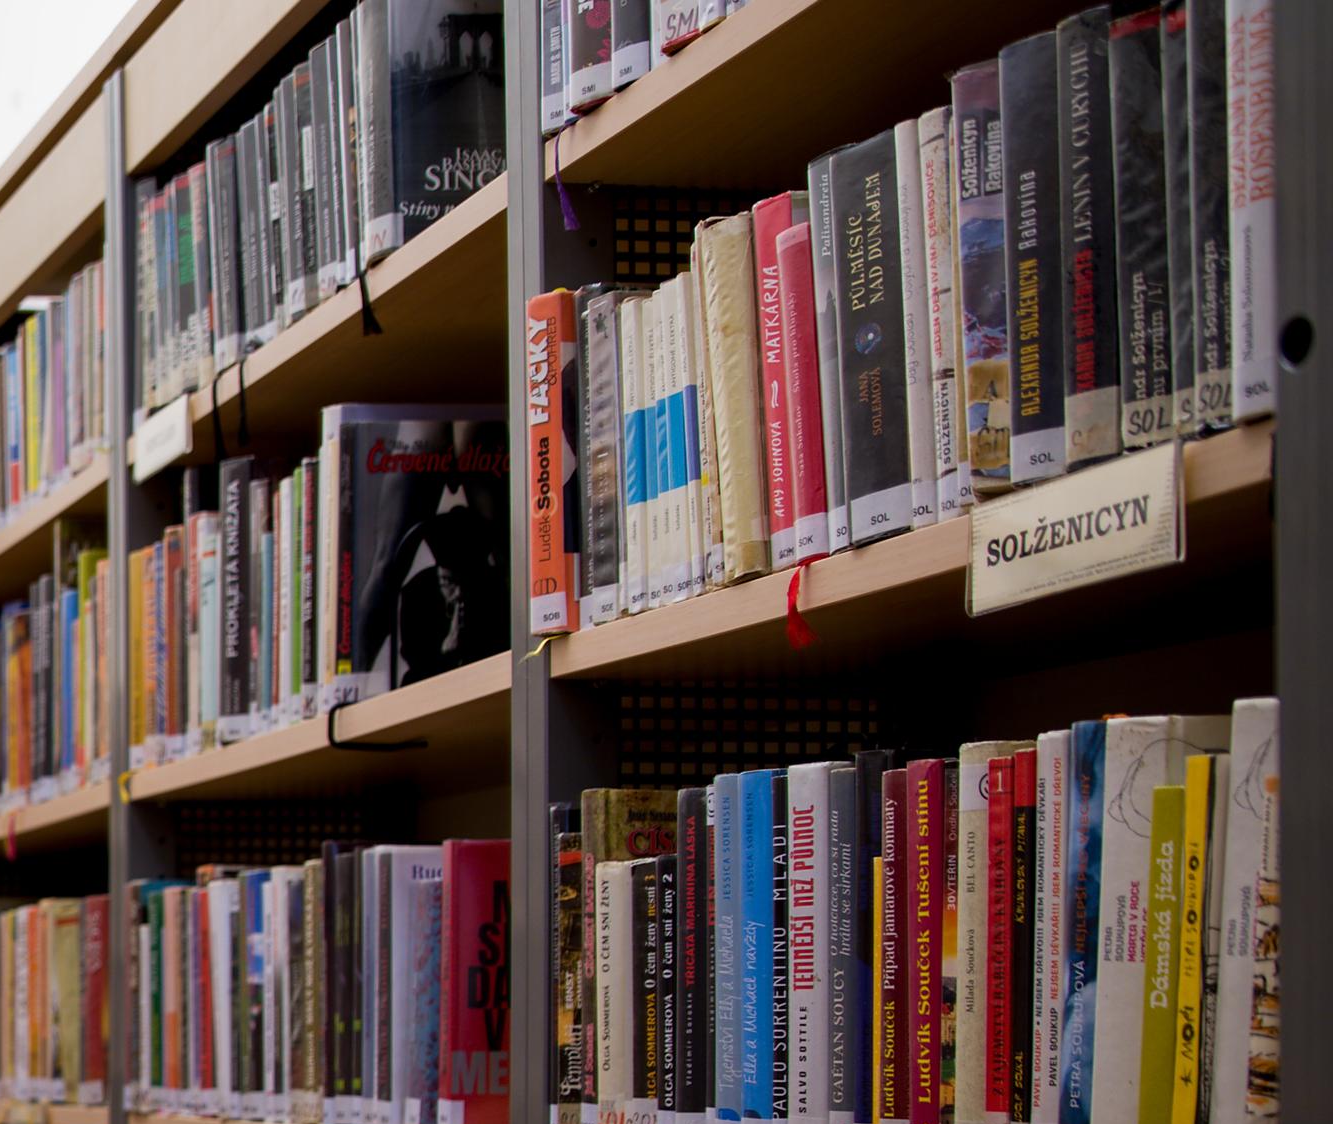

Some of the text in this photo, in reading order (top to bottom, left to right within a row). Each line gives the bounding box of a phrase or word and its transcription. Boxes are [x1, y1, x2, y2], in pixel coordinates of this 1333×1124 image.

[1070, 39, 1092, 243] LENIN CURYCHU
[1249, 5, 1274, 203] ROSENBLUMA
[456, 146, 502, 165] ISAAC
[961, 119, 978, 197] Solženicyn
[984, 120, 1002, 192] Rakovina
[819, 174, 832, 256] Palisandreia
[865, 172, 884, 303] NAD DUNAJEM
[1018, 170, 1038, 249] Rakovina
[848, 212, 866, 311] PŮLMĚSÍC
[762, 264, 781, 363] MATKÁRNA
[1016, 258, 1040, 416] ALEXANDR SOLŽENICYN
[1131, 273, 1145, 364] Solženicyn
[529, 318, 550, 426] FACKY
[859, 371, 869, 403] JANA
[870, 367, 883, 436] SOLEMOVÁ
[538, 437, 551, 561] Luděk Sobota
[770, 421, 786, 517] AMY SOHNOVÁ
[1030, 453, 1055, 465] SOL
[871, 513, 890, 526] SOL
[987, 495, 1150, 567] SOLŽENICYN
[600, 879, 610, 907] ŽENY
[685, 863, 696, 930] MARININA
[722, 797, 731, 900] JESSICA SORENSEN
[881, 798, 898, 989] Případ jantarové komnaty
[915, 779, 930, 922] Tušení stínu
[966, 831, 976, 892] BEL CANTO
[645, 886, 658, 974] čem ženy nesní
[662, 887, 676, 964] čem sní ženy
[790, 805, 815, 991] TEMNĚJŠÍ NEŽ PŮLNOC
[838, 844, 852, 956] hrála sirkami
[1050, 801, 1062, 999] NEJSEM JSEM ROMANTICKÉ
[1150, 839, 1176, 1009] Dámská jízda
[742, 921, 765, 1084] Ella Michael navždy
[832, 967, 845, 1026] SOUCY
[965, 929, 975, 1013] Milada Součková
[1036, 897, 1045, 1017] NEJSEM JSEM
[645, 993, 656, 1069] SOMMEROVÁ
[663, 993, 675, 1106] OLGA SOMMEROVÁ
[798, 1006, 807, 1113] SALVO SOTTILE
[882, 1000, 896, 1117] Ludvík Souček
[915, 929, 931, 1103] Ludvík Souček
[1034, 1029, 1042, 1072] SOUKUP
[1049, 1008, 1058, 1086] PAVEL SOUKUP
[1070, 961, 1085, 1108] PETRA SOUKUPOVÁ
